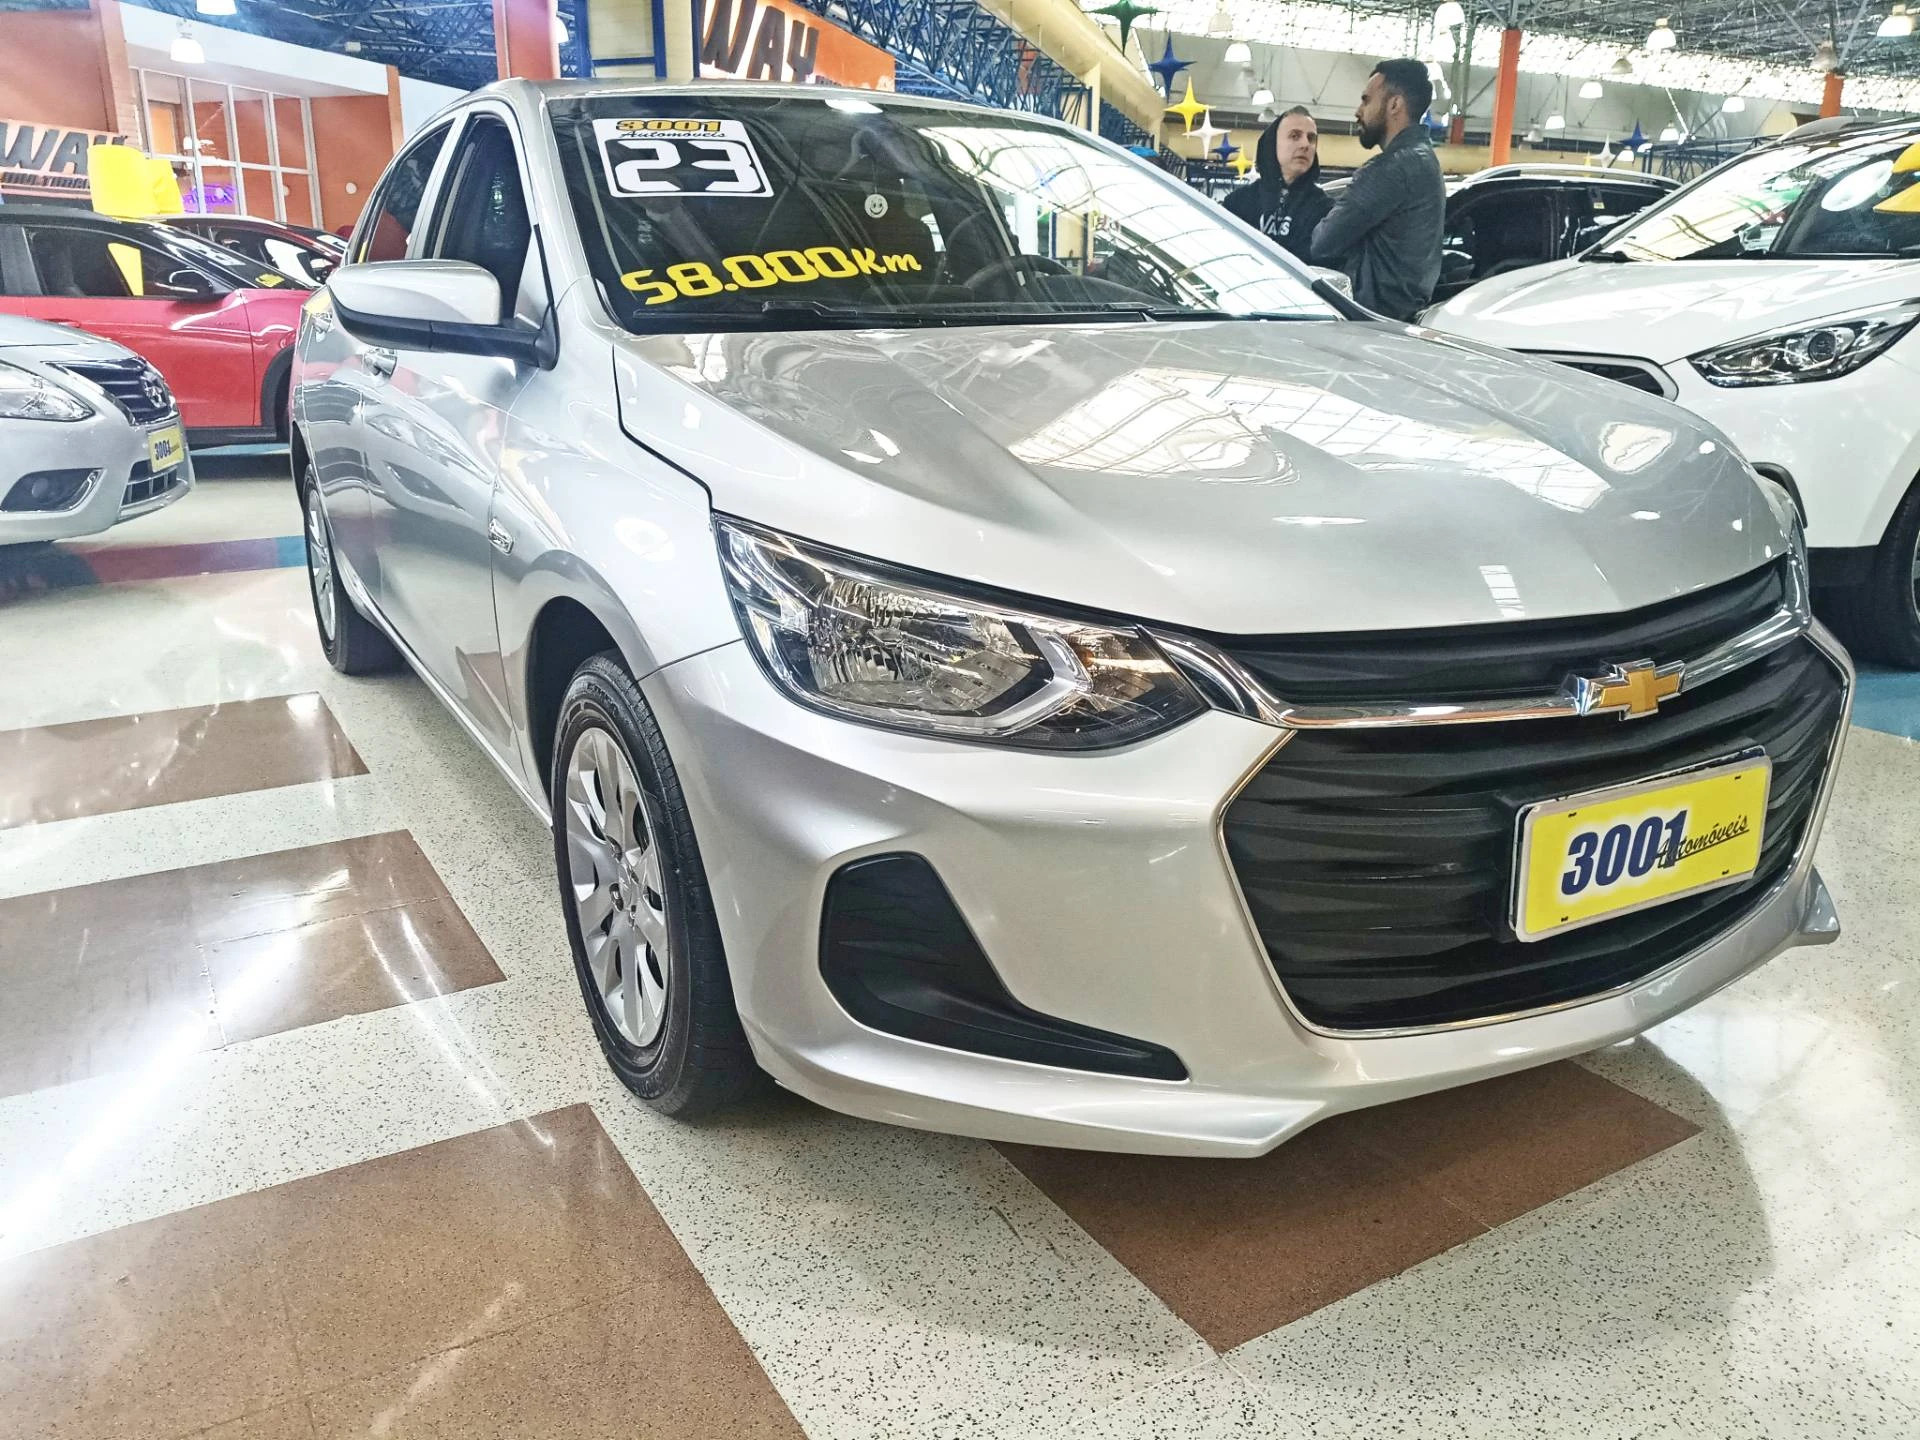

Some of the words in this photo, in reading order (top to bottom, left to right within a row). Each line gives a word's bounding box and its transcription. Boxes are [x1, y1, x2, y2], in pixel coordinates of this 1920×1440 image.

[0, 122, 126, 174] WA
[616, 120, 721, 132] 3001
[614, 140, 761, 192] 23
[155, 439, 171, 460] 3001
[1561, 810, 1687, 895] 3001
